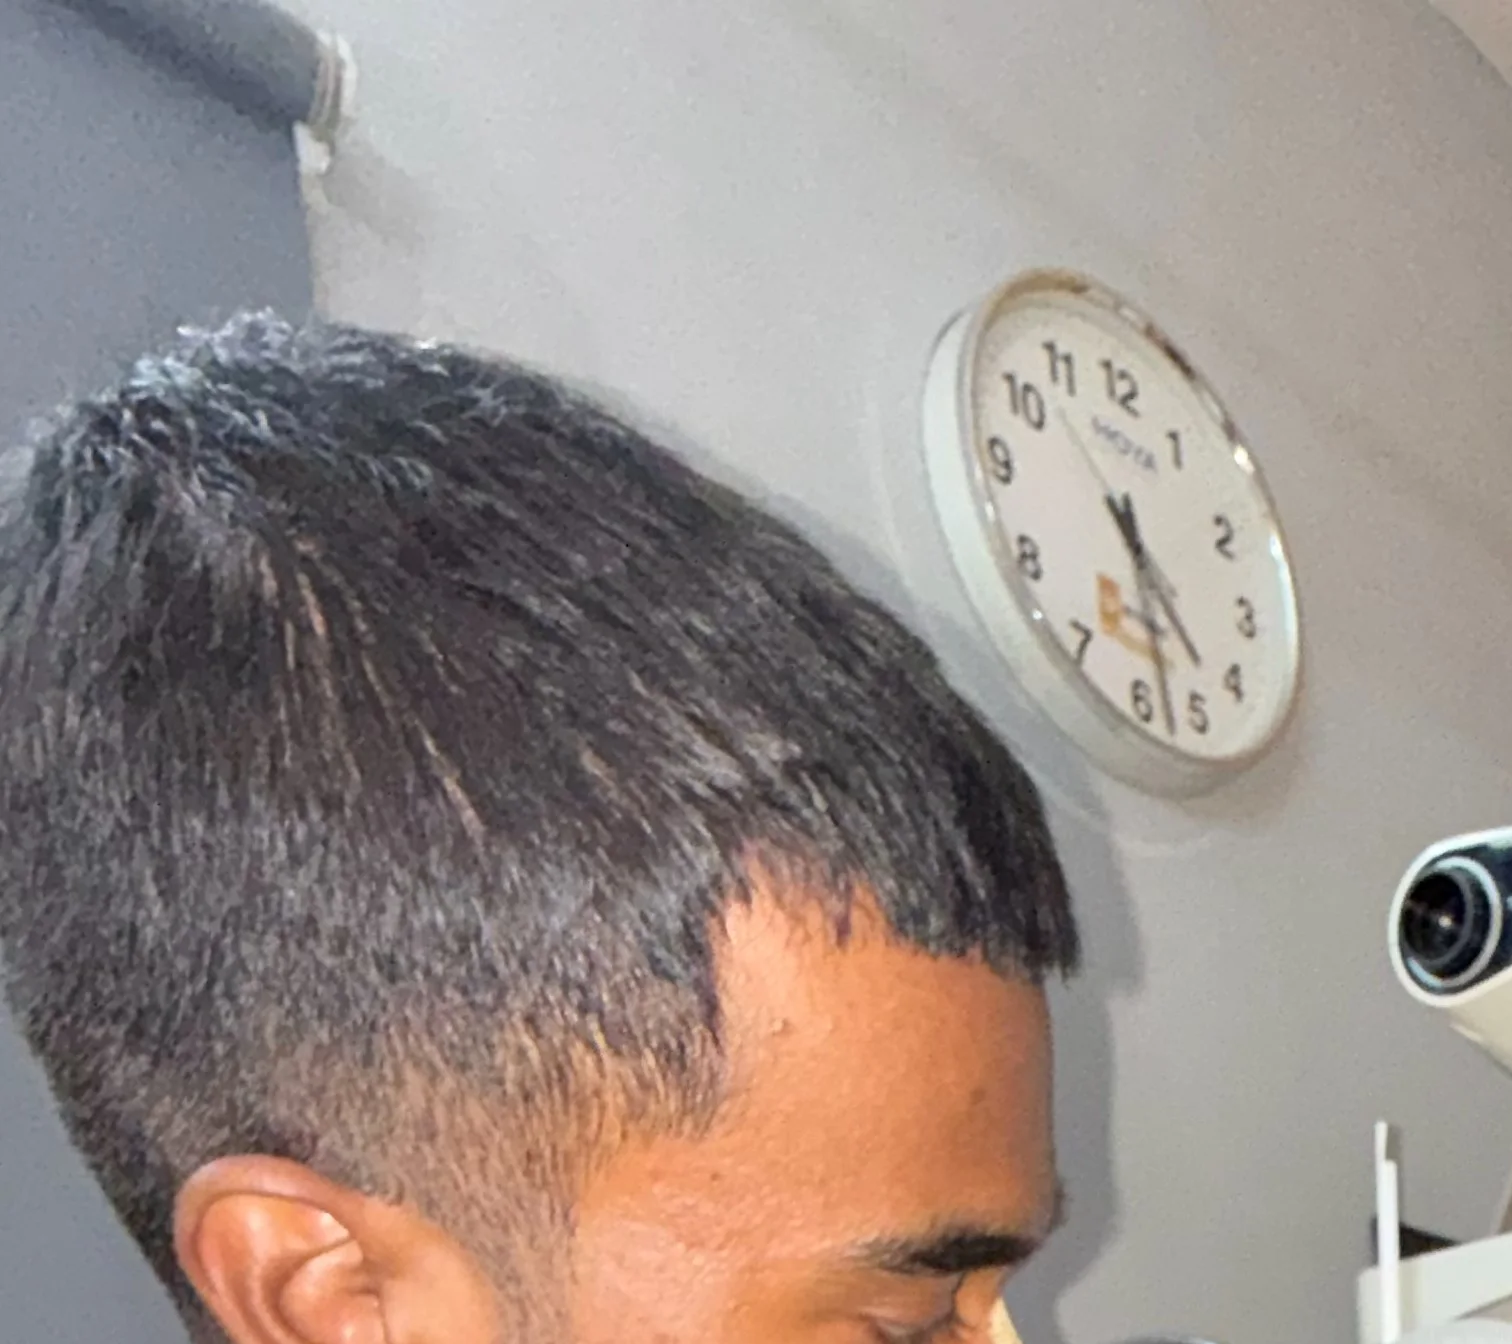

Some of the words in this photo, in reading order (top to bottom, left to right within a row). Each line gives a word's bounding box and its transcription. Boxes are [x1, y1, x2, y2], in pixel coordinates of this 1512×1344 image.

[1042, 341, 1077, 397] 11
[1100, 358, 1140, 418] 12
[1003, 371, 1045, 431] 10
[989, 436, 1014, 485] 9
[1167, 430, 1182, 469] 1
[1017, 535, 1043, 581] 8
[1214, 515, 1236, 559] 2
[1237, 597, 1257, 640] 3
[1071, 620, 1093, 664] 7
[1132, 679, 1153, 723] 6
[1225, 663, 1243, 703] 4
[1189, 693, 1209, 735] 5
